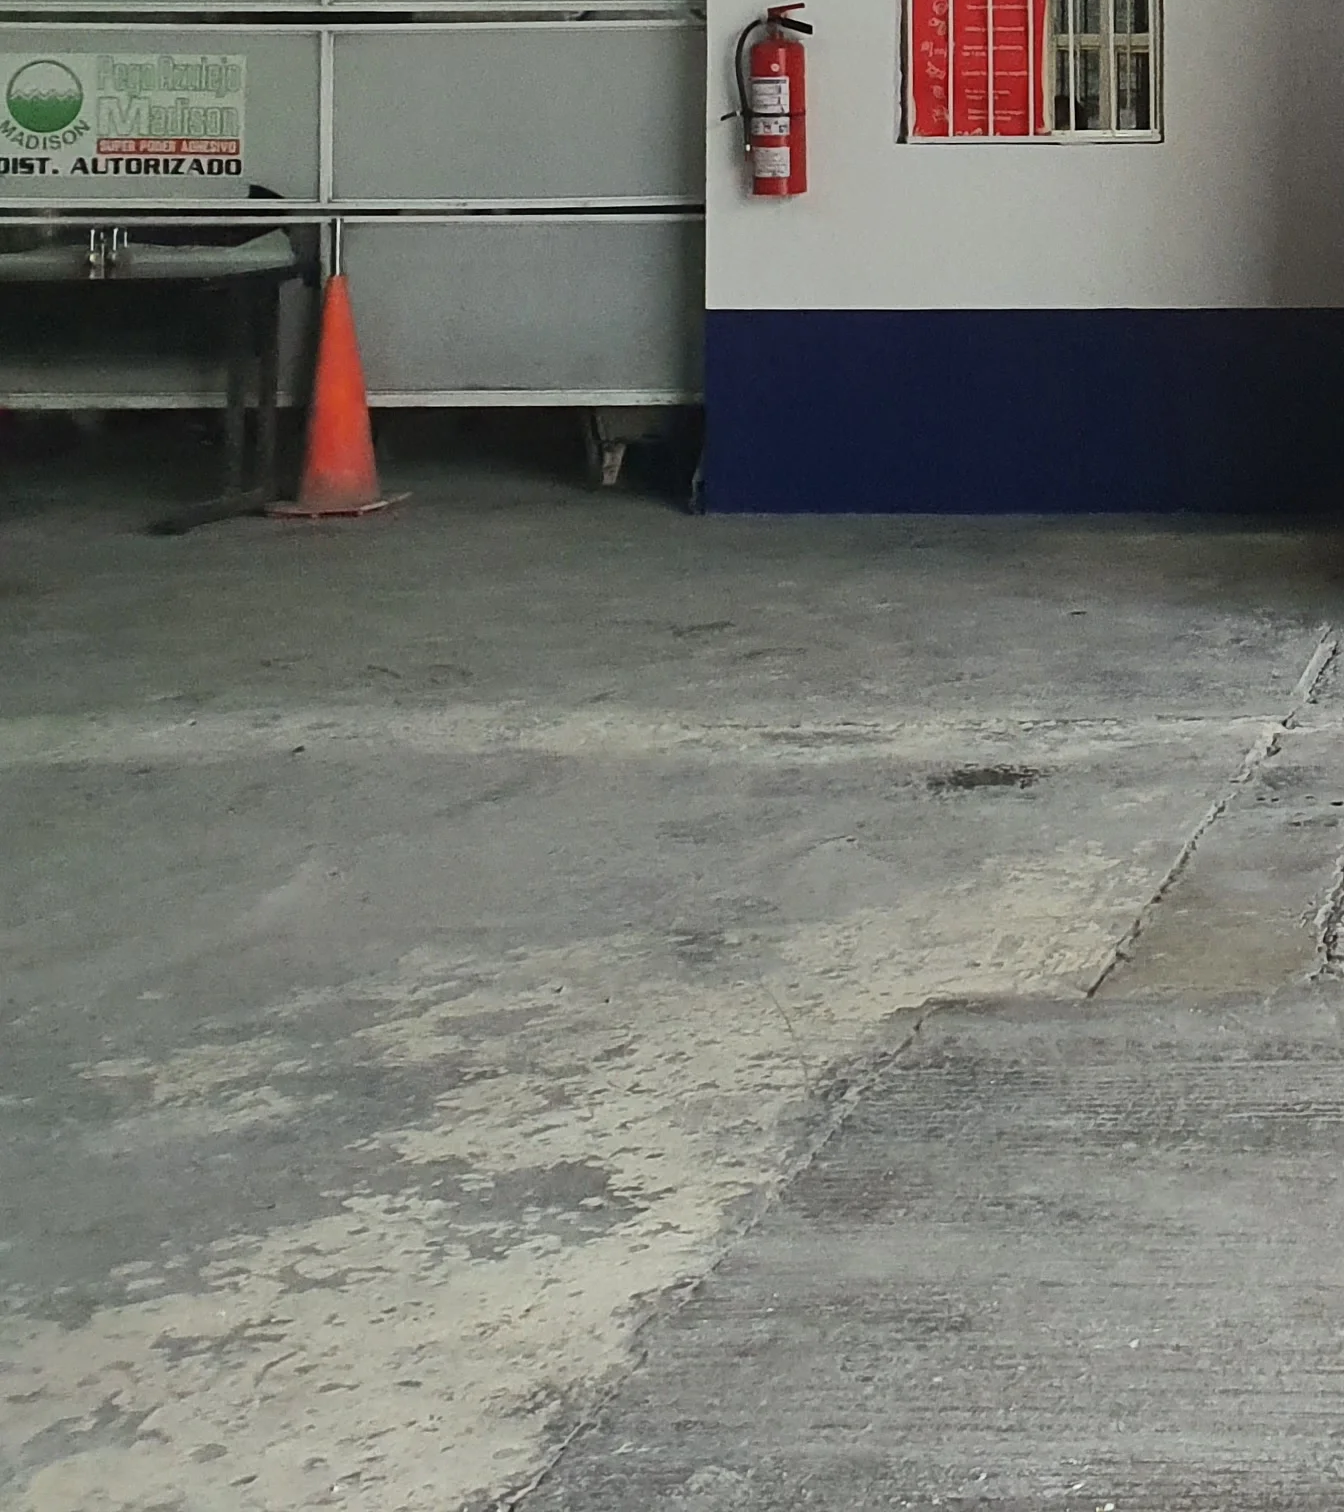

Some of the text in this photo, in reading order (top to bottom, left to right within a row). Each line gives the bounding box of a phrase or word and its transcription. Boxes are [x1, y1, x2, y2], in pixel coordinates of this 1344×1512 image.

[97, 96, 239, 136] Madison
[0, 120, 90, 150] MADISON
[70, 157, 242, 175] AUTORIZADO
